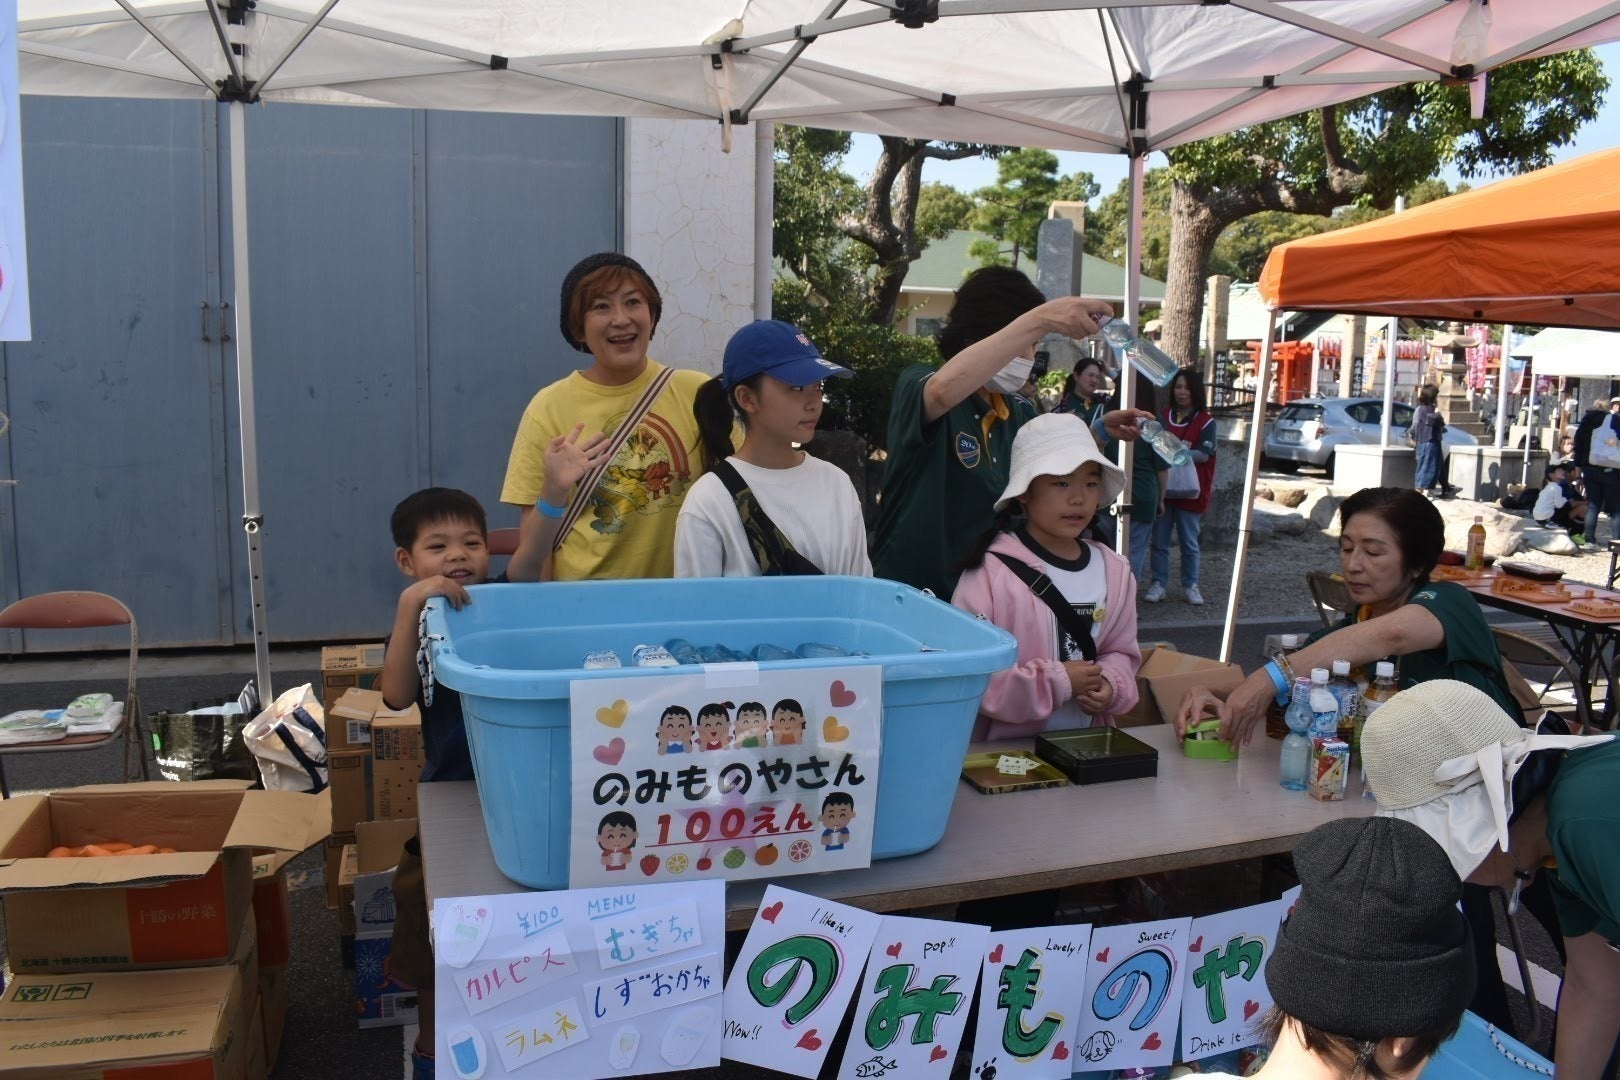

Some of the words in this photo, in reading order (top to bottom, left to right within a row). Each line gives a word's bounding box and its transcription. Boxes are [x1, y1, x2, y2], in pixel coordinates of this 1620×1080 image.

[592, 752, 865, 806] のみものやさん
[656, 803, 812, 845] 100えん
[517, 906, 559, 934] ¥100
[588, 894, 636, 915] MENU
[819, 911, 836, 927] like
[605, 915, 695, 962] むぎちゃ
[1045, 938, 1083, 958] Lovely!
[1137, 928, 1177, 944] Sweet!
[594, 964, 711, 1018] しずおかちゃ
[747, 935, 842, 1026] の
[1092, 948, 1173, 1032] の
[1192, 936, 1264, 1025] や
[865, 963, 963, 1051] み
[997, 948, 1062, 1058] も
[505, 1012, 577, 1056] ラムネ
[723, 1019, 763, 1041] Wow!!
[1190, 1035, 1225, 1055] Drink
